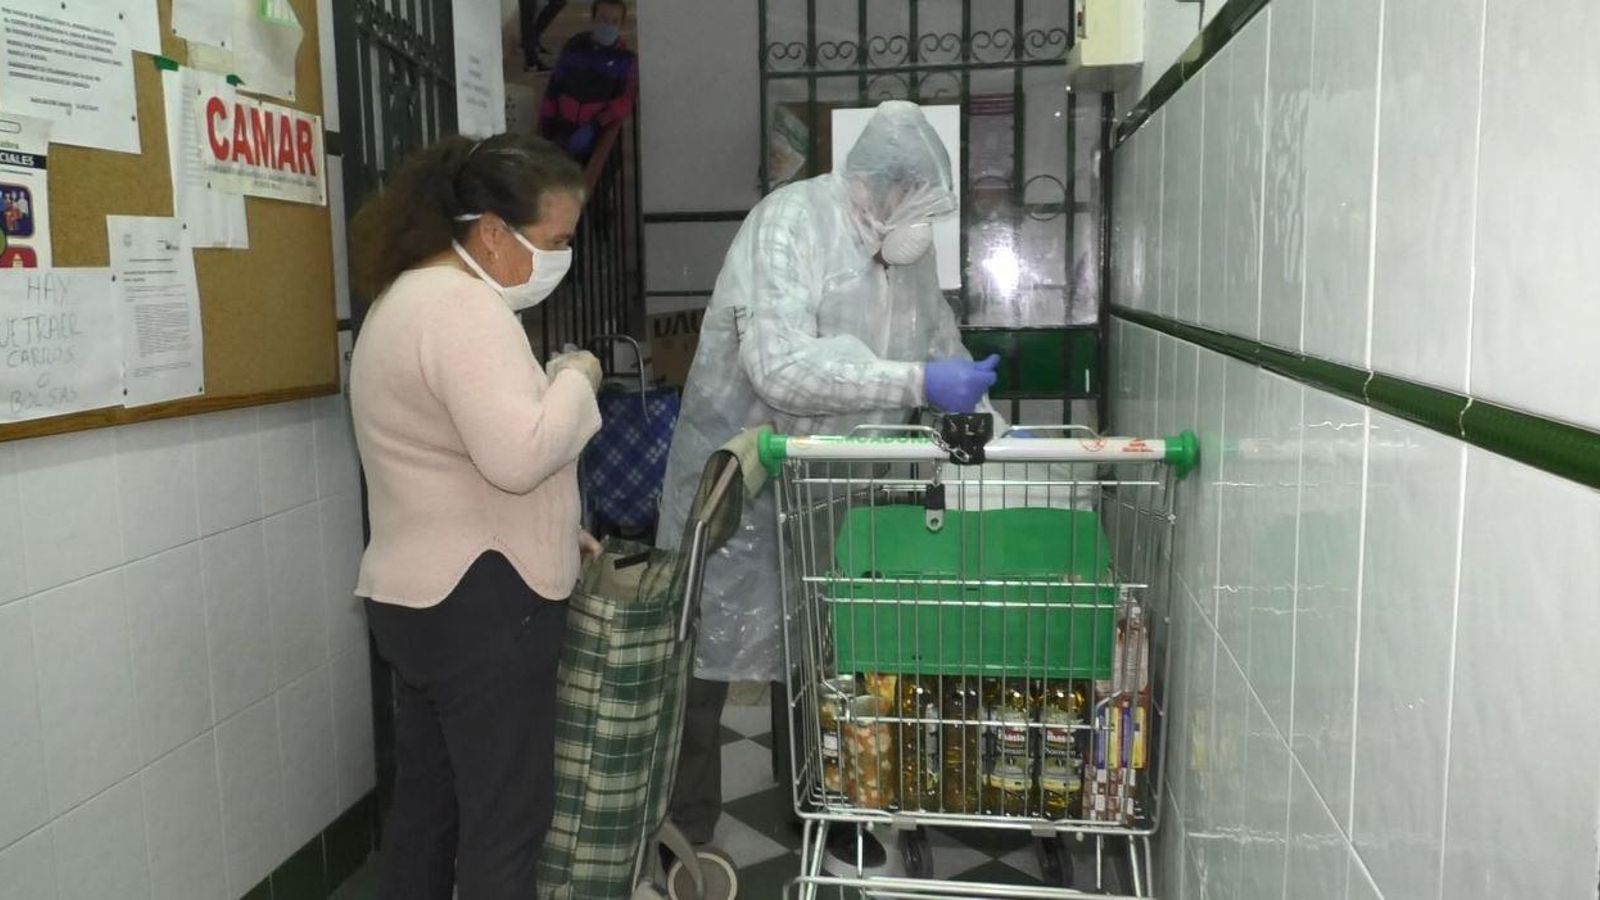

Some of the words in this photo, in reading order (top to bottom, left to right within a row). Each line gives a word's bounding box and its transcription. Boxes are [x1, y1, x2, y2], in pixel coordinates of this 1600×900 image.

[206, 96, 316, 177] CAMAR
[27, 272, 71, 305] HAY
[10, 386, 78, 414] BOLSAS
